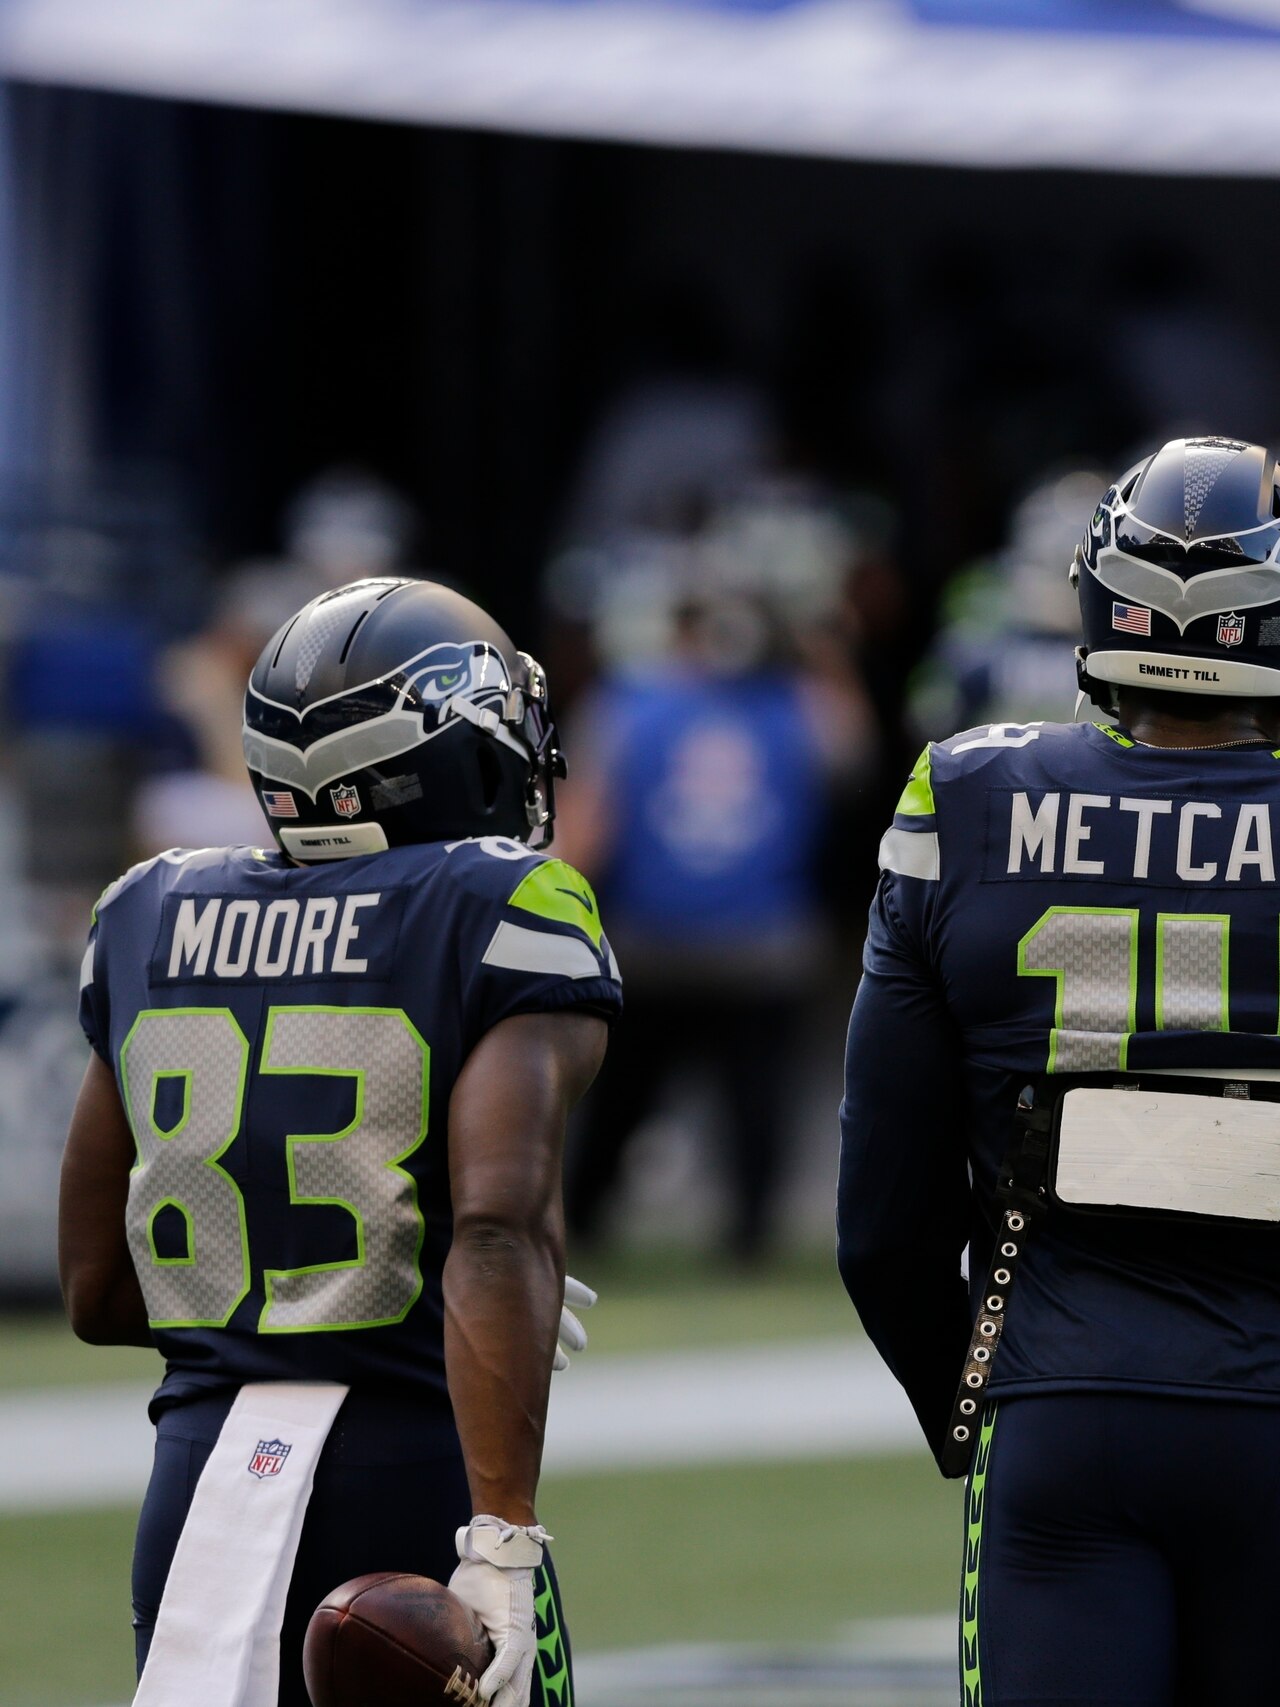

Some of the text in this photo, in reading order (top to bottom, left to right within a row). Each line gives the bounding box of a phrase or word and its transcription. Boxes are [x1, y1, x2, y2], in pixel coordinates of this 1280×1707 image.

[1220, 628, 1240, 642] NFL
[1139, 664, 1220, 682] EMMETT TILL
[337, 800, 357, 812] NFL
[332, 836, 351, 845] TILL
[167, 892, 382, 979] MOORE
[120, 1005, 431, 1335] 83
[251, 1454, 281, 1474] NFL
